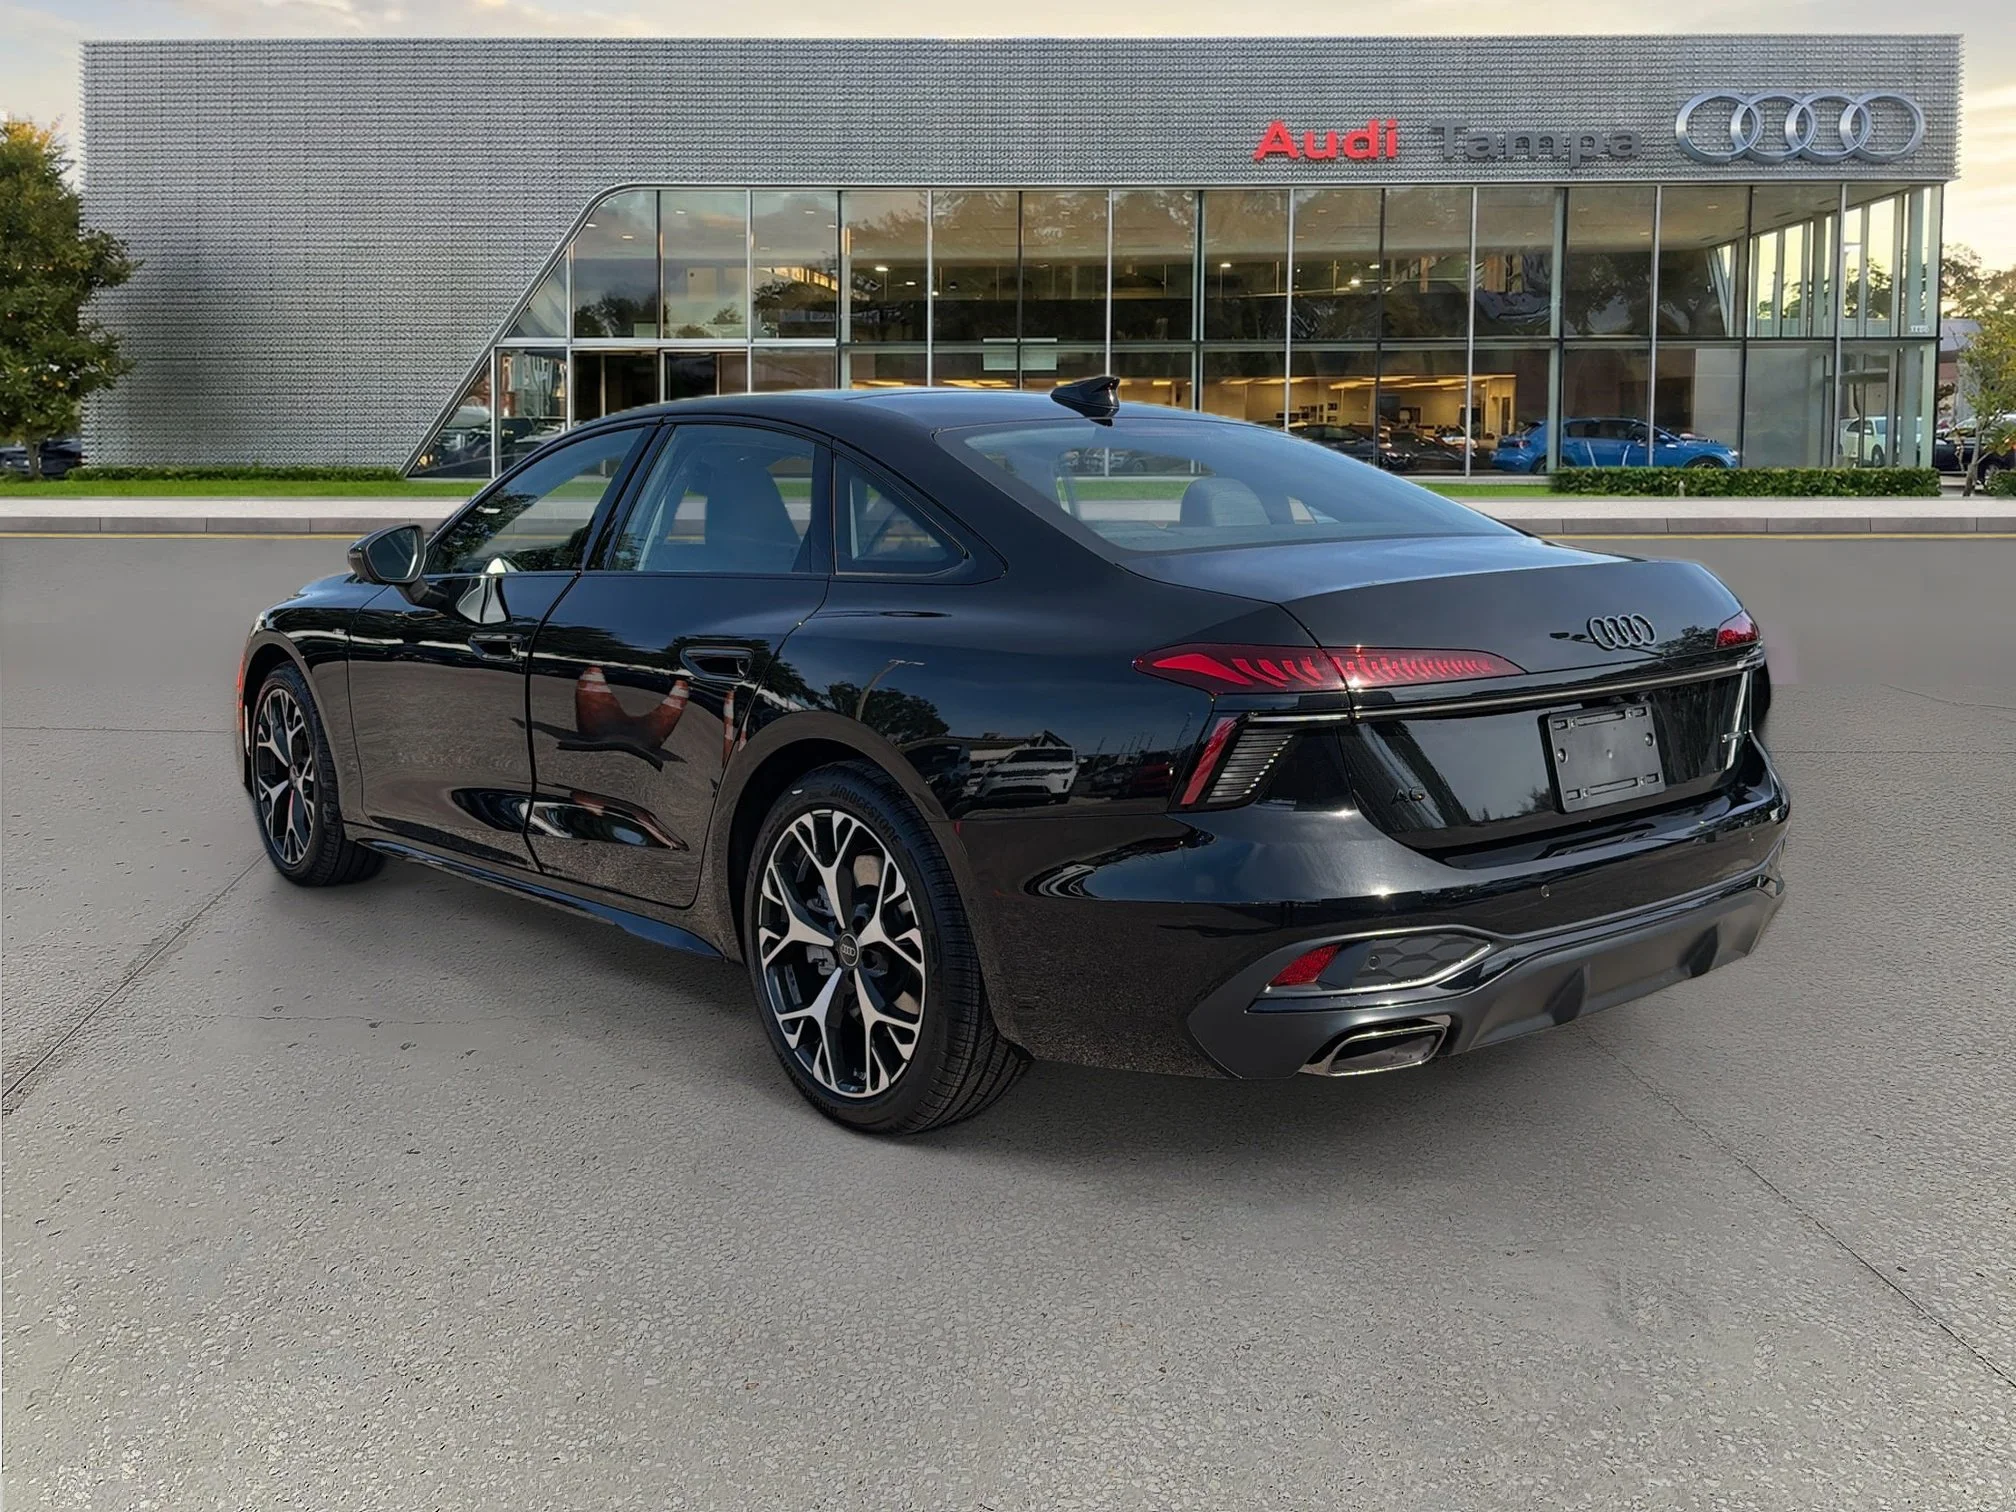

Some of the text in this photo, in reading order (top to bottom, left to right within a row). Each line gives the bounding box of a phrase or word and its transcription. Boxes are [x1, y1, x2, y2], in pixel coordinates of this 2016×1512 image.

[1253, 118, 1643, 169] Audi Tampa
[830, 783, 902, 846] BRIDGESTONE
[1391, 787, 1425, 804] A6
